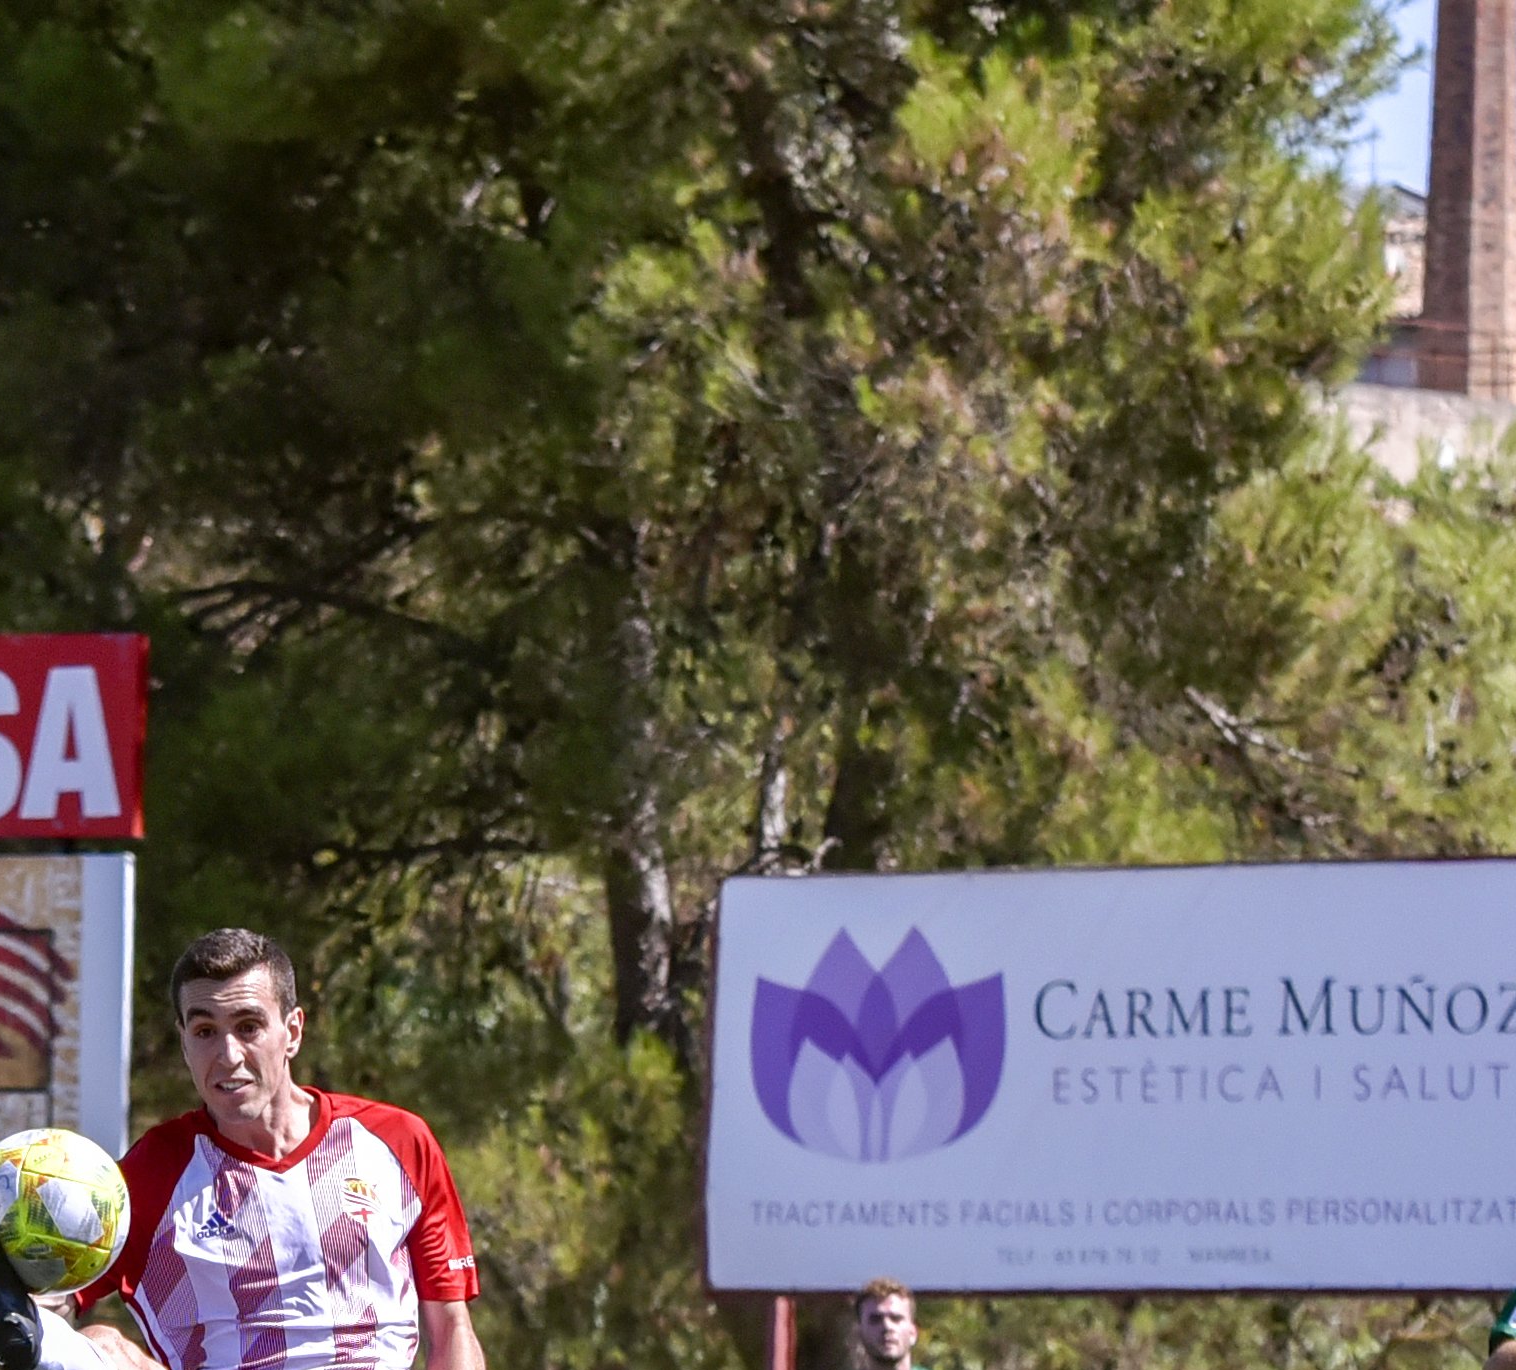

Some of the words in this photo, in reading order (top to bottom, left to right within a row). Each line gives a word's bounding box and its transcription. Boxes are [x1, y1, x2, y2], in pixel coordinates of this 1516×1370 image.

[1034, 978, 1253, 1041] CARME
[1052, 1059, 1284, 1105] ESTÈTICA
[1353, 1061, 1510, 1102] SALUT
[750, 1199, 950, 1228] TRACTAMENTS
[960, 1199, 1075, 1228] FACIALS
[1103, 1199, 1275, 1227] CORPORALS
